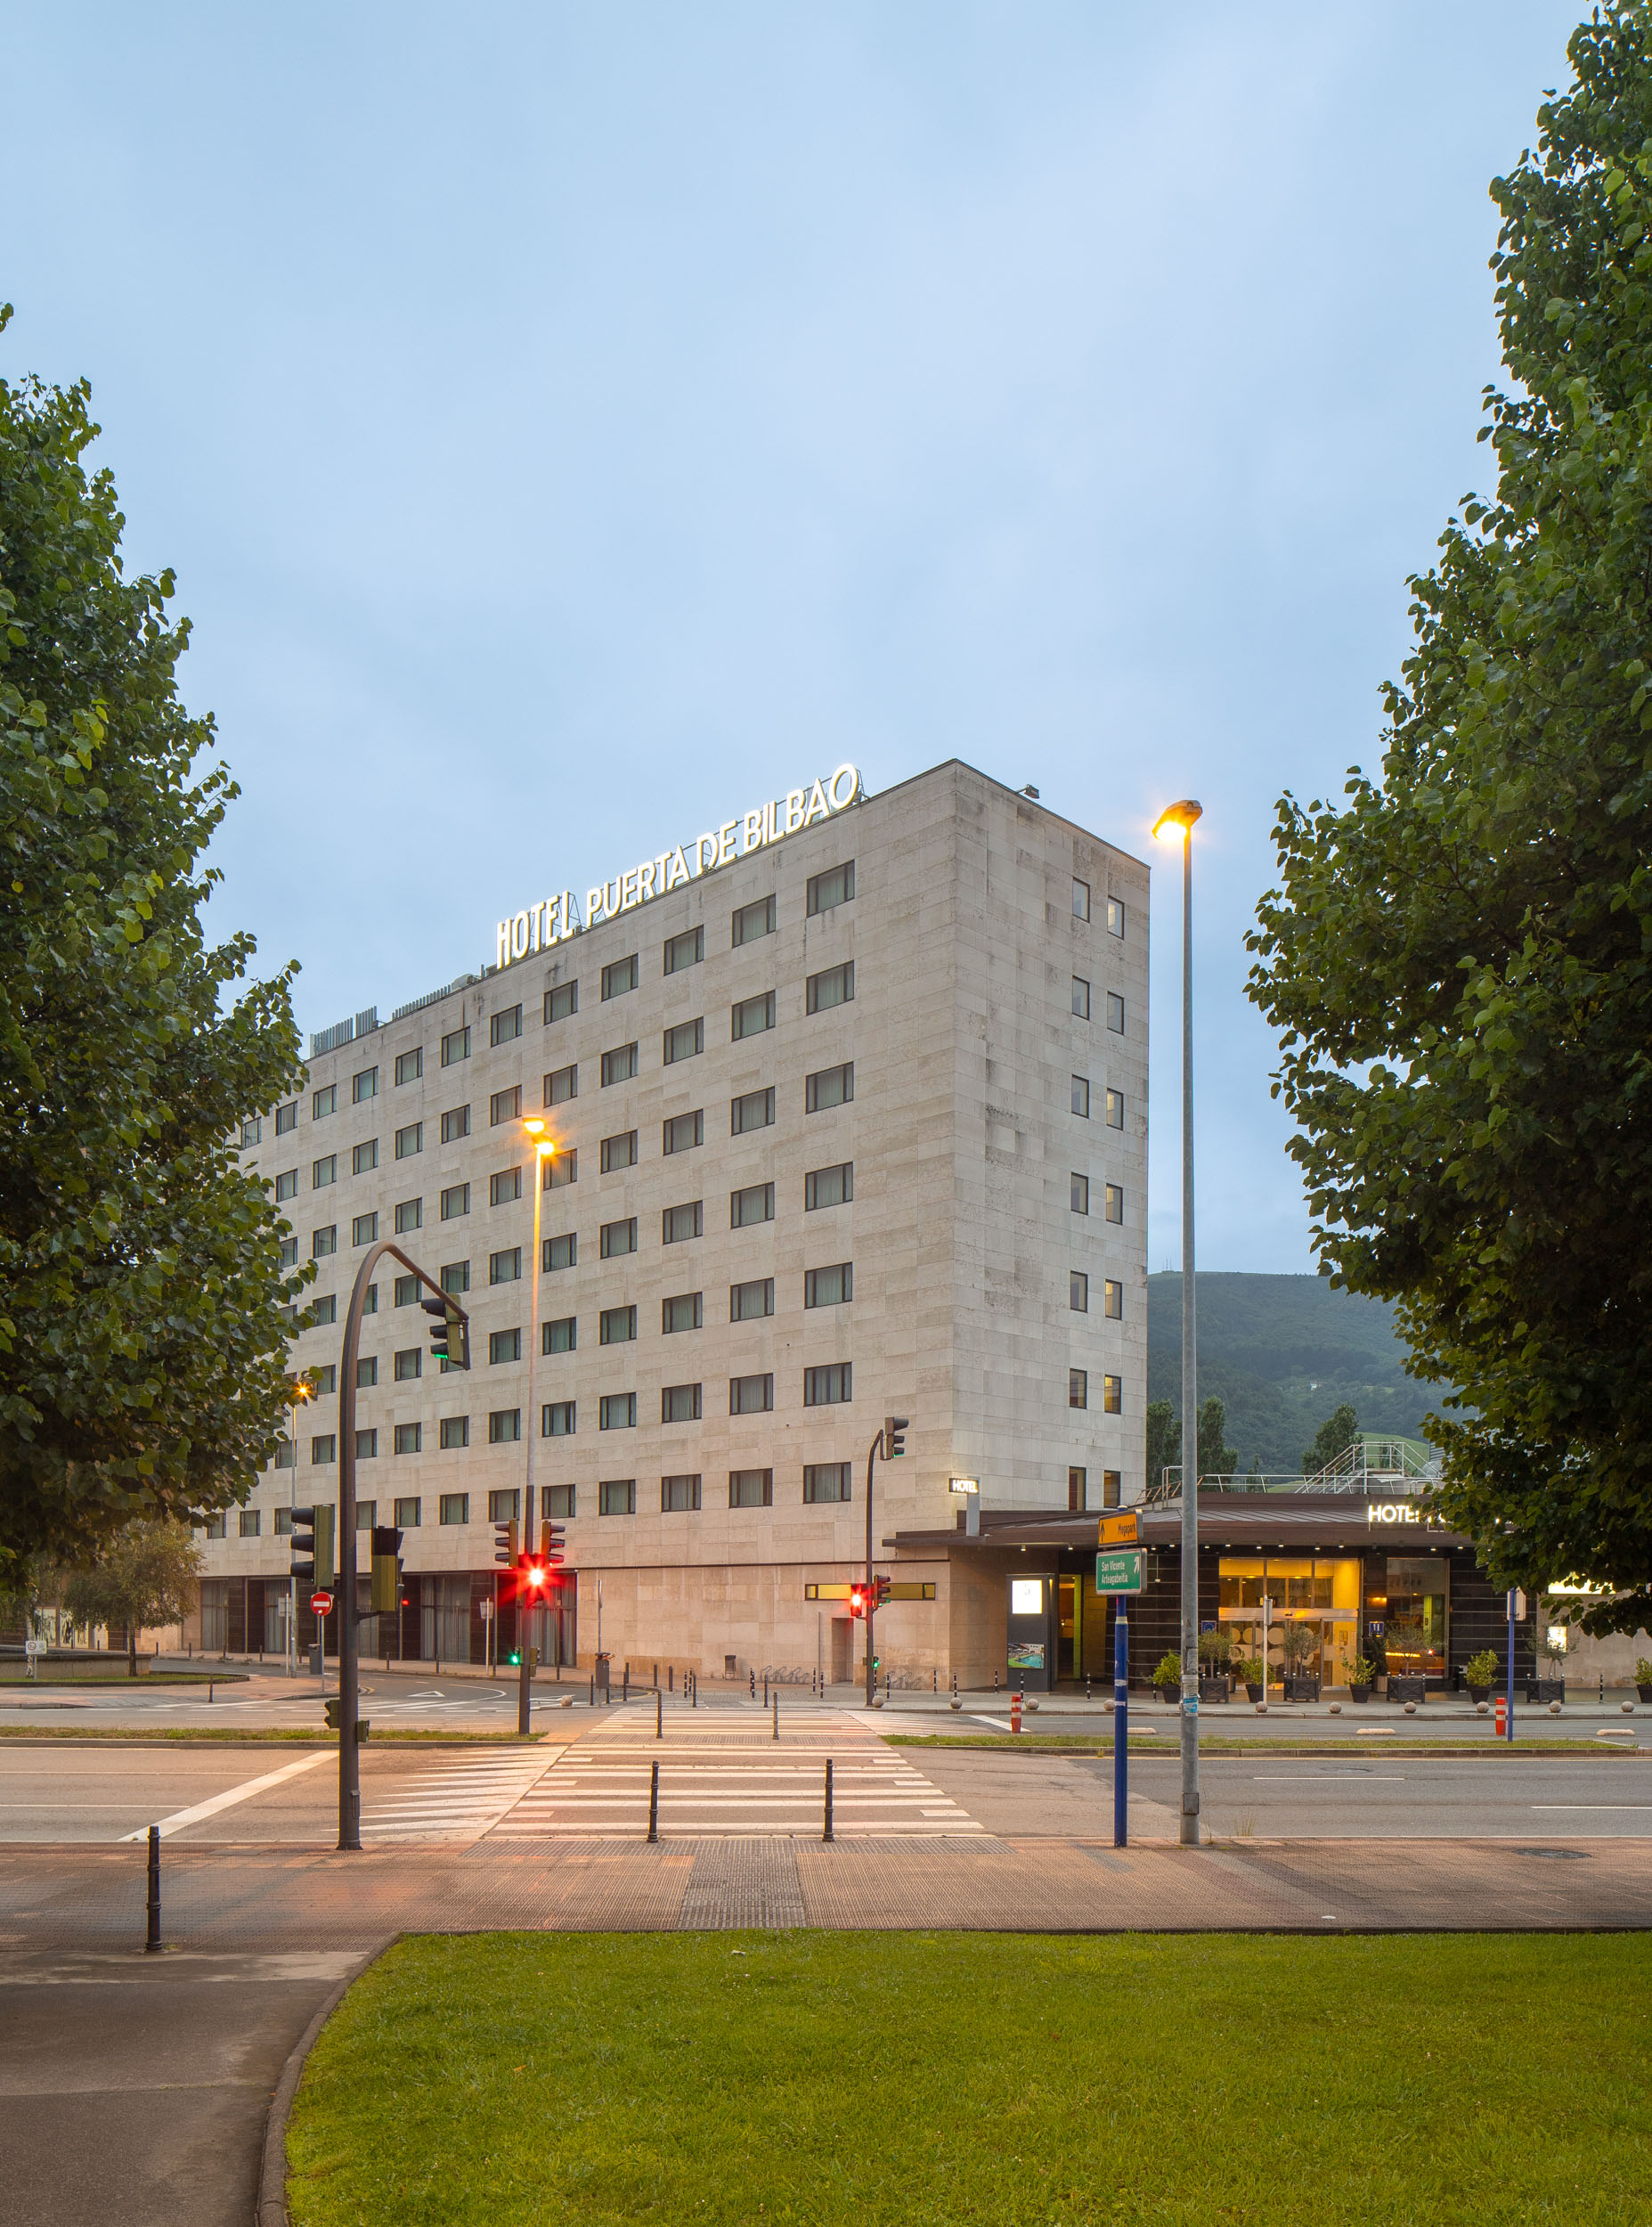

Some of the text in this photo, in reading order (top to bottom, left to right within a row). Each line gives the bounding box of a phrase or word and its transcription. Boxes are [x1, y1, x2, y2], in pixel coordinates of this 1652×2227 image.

[497, 763, 859, 969] HOTEL PUERTA DE BILBAO
[952, 1479, 978, 1494] HOTEL
[1101, 1560, 1126, 1572] San Vicente
